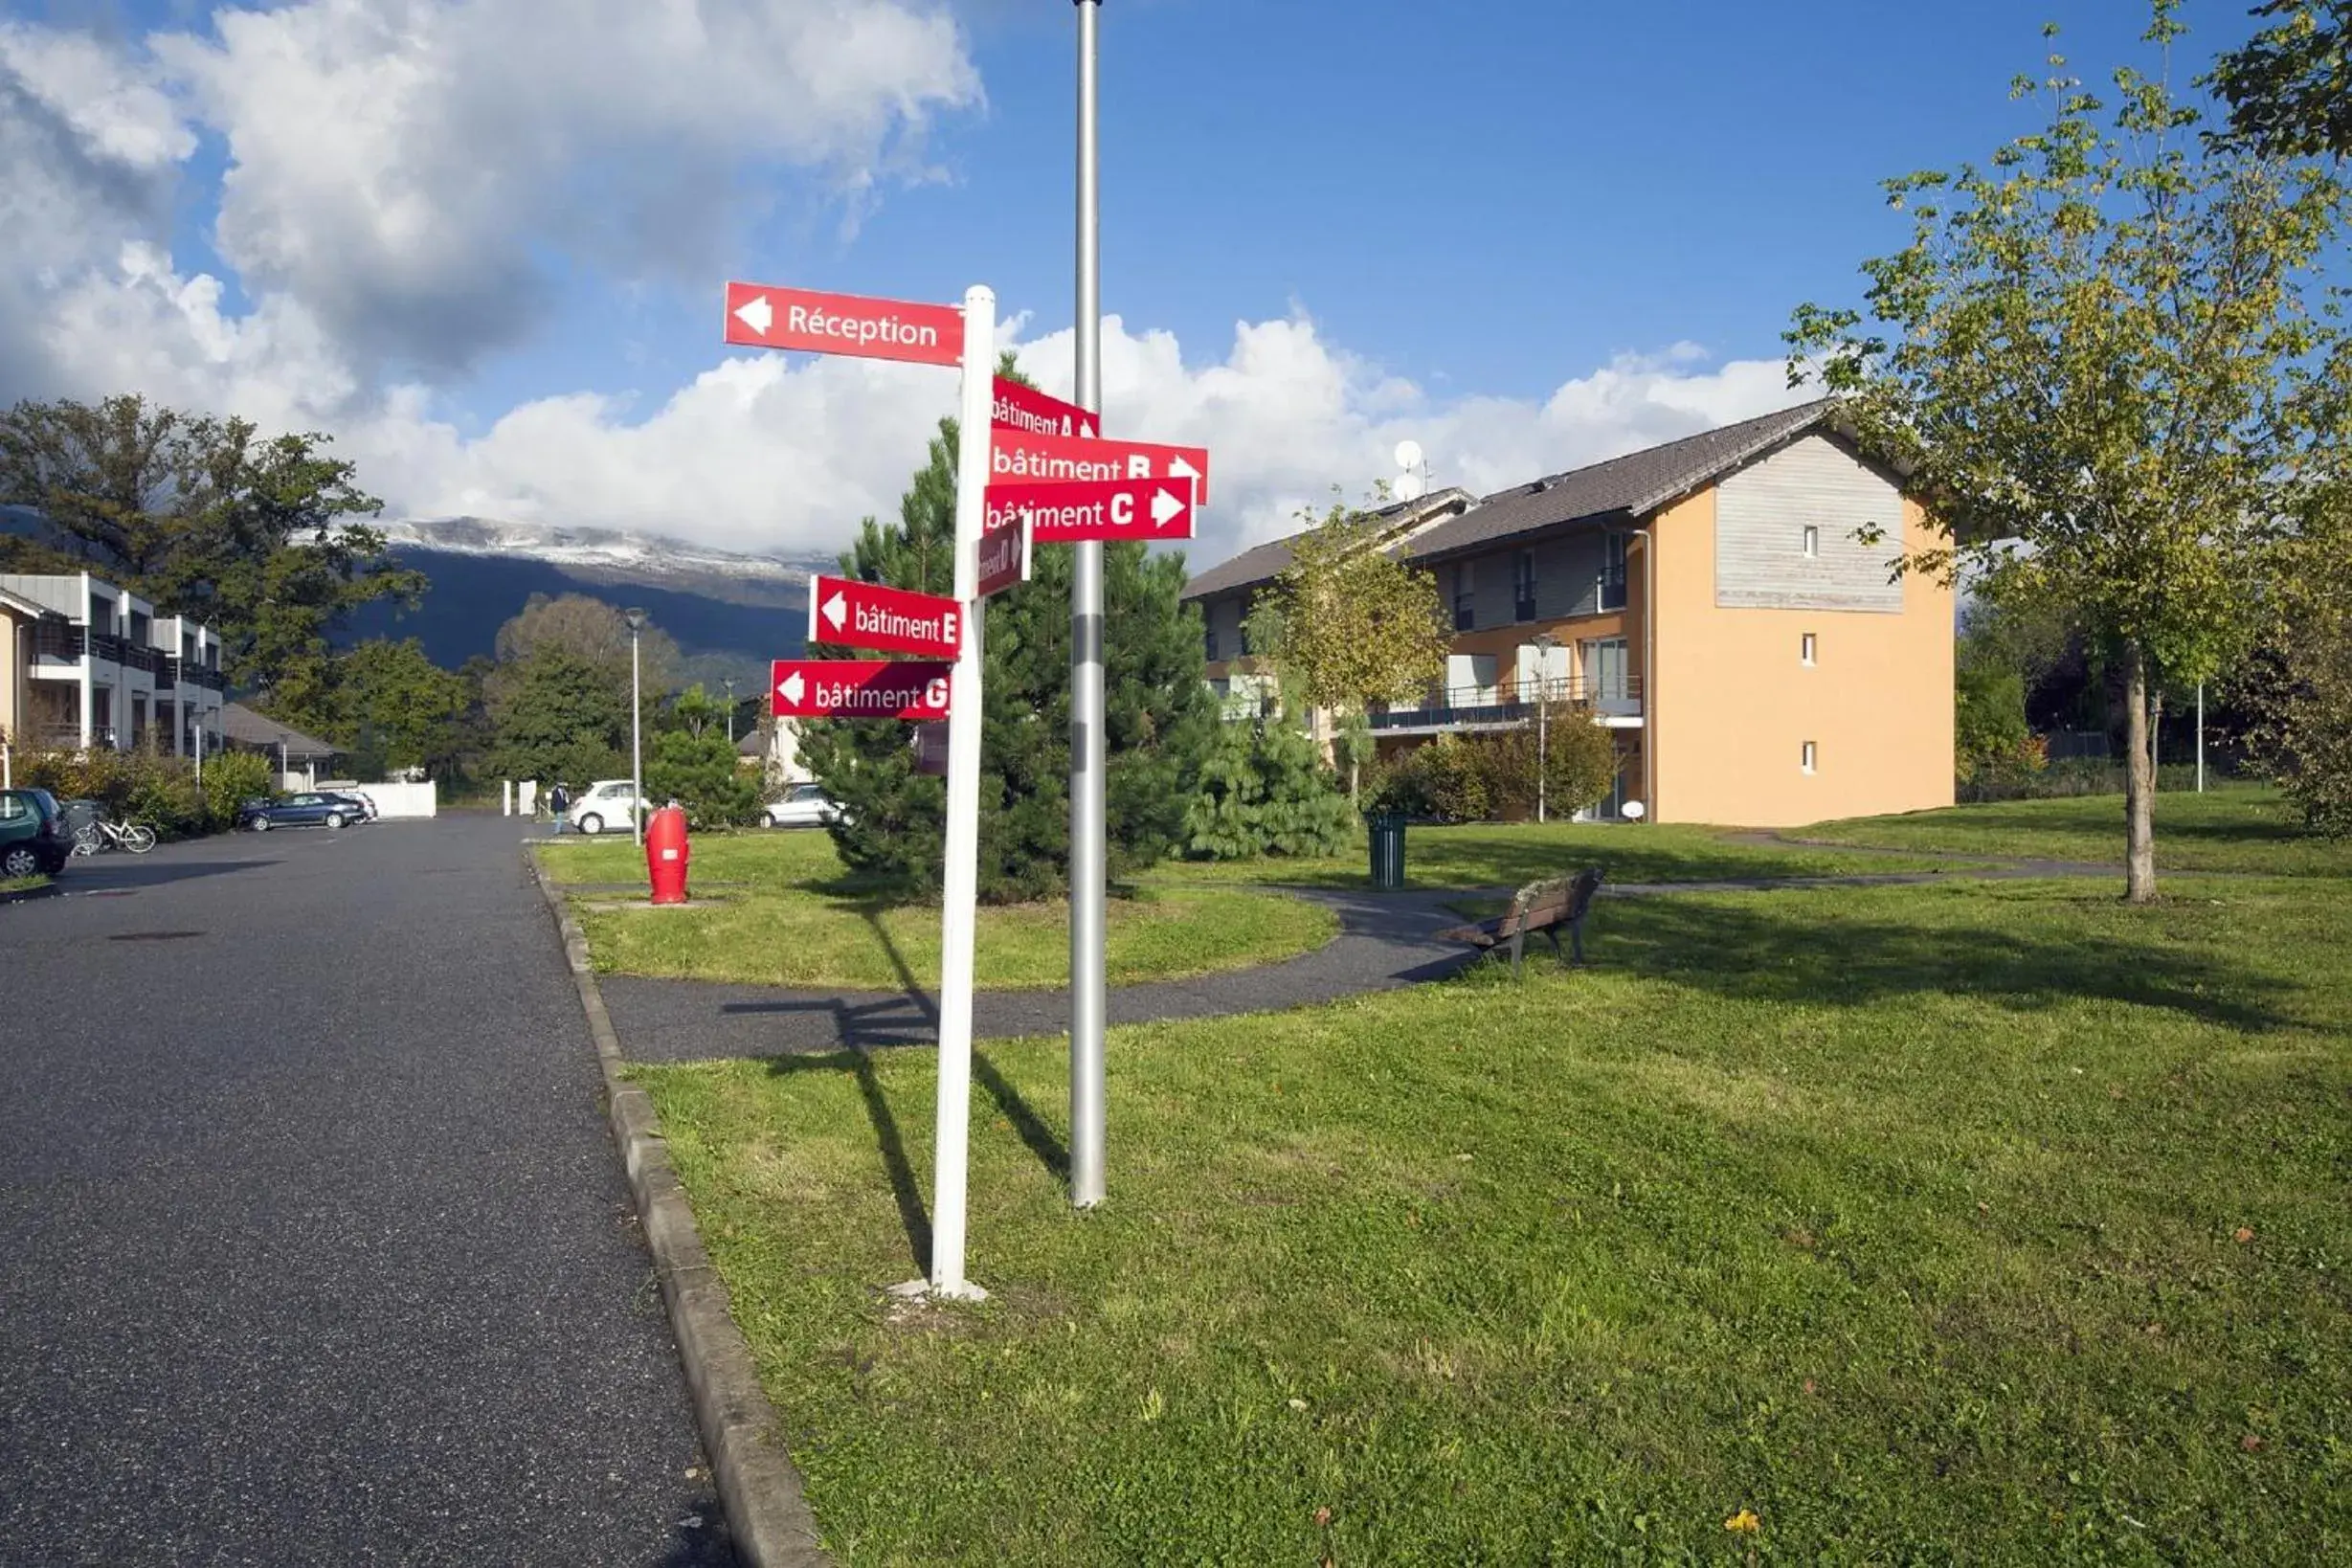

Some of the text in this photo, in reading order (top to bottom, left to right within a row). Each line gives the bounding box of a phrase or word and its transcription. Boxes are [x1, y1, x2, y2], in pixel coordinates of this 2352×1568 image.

[788, 304, 937, 346] Réception
[992, 395, 1072, 437] bâtiment A
[993, 445, 1122, 482] bâtiment
[1110, 493, 1133, 525] C
[855, 601, 957, 644] bâtiment E
[816, 677, 949, 708] bâtiment G
